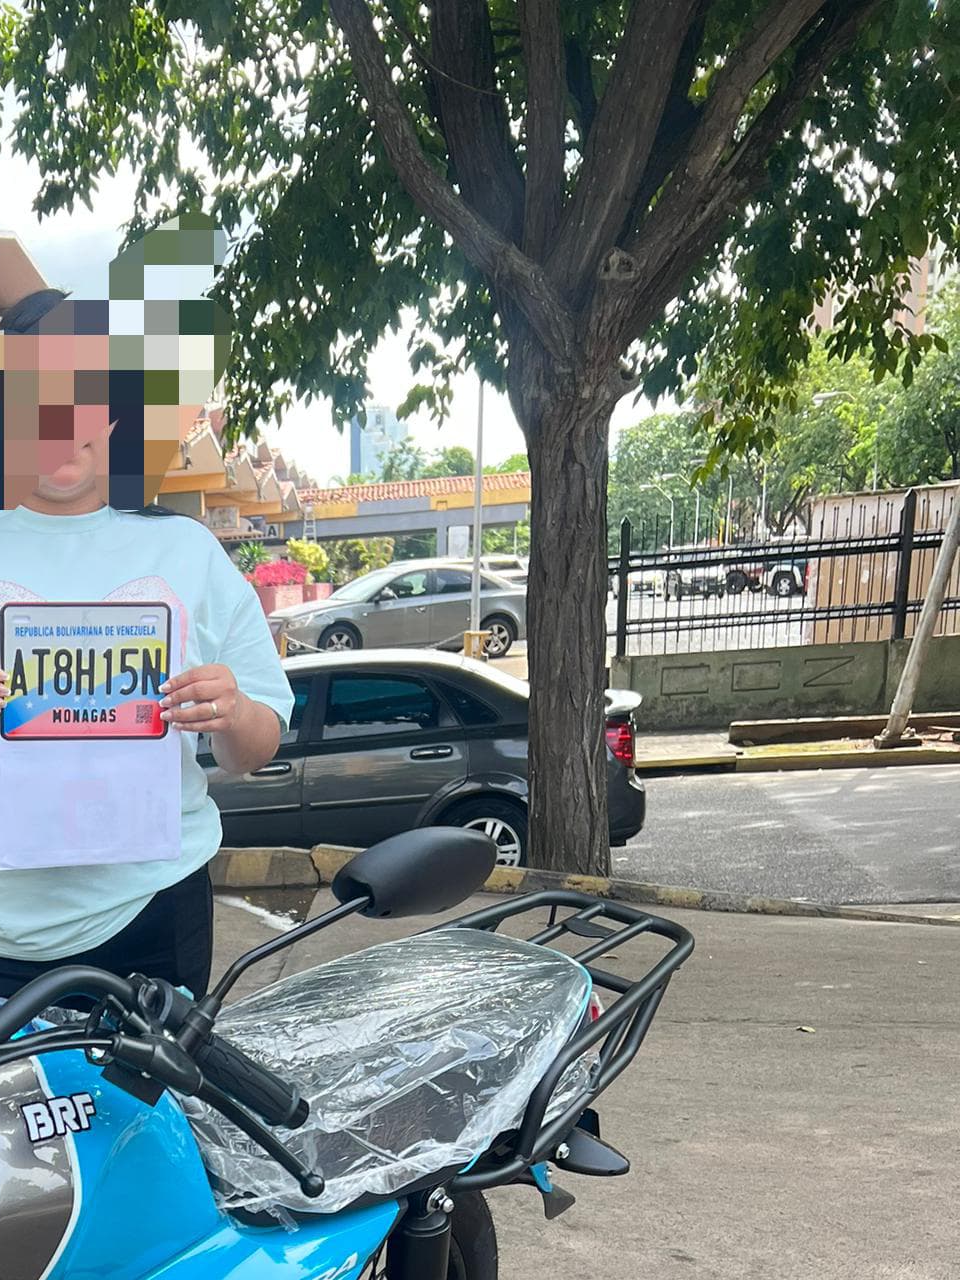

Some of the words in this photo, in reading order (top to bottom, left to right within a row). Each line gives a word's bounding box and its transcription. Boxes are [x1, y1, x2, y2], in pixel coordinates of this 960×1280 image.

[15, 626, 54, 637] REPUBLICA
[56, 626, 103, 637] BOLIVARIANA
[104, 626, 115, 637] DE
[116, 625, 156, 636] VENEZUELA
[10, 648, 162, 697] AT8H15N
[52, 708, 117, 723] MONAGAS
[21, 1092, 96, 1142] BRF
